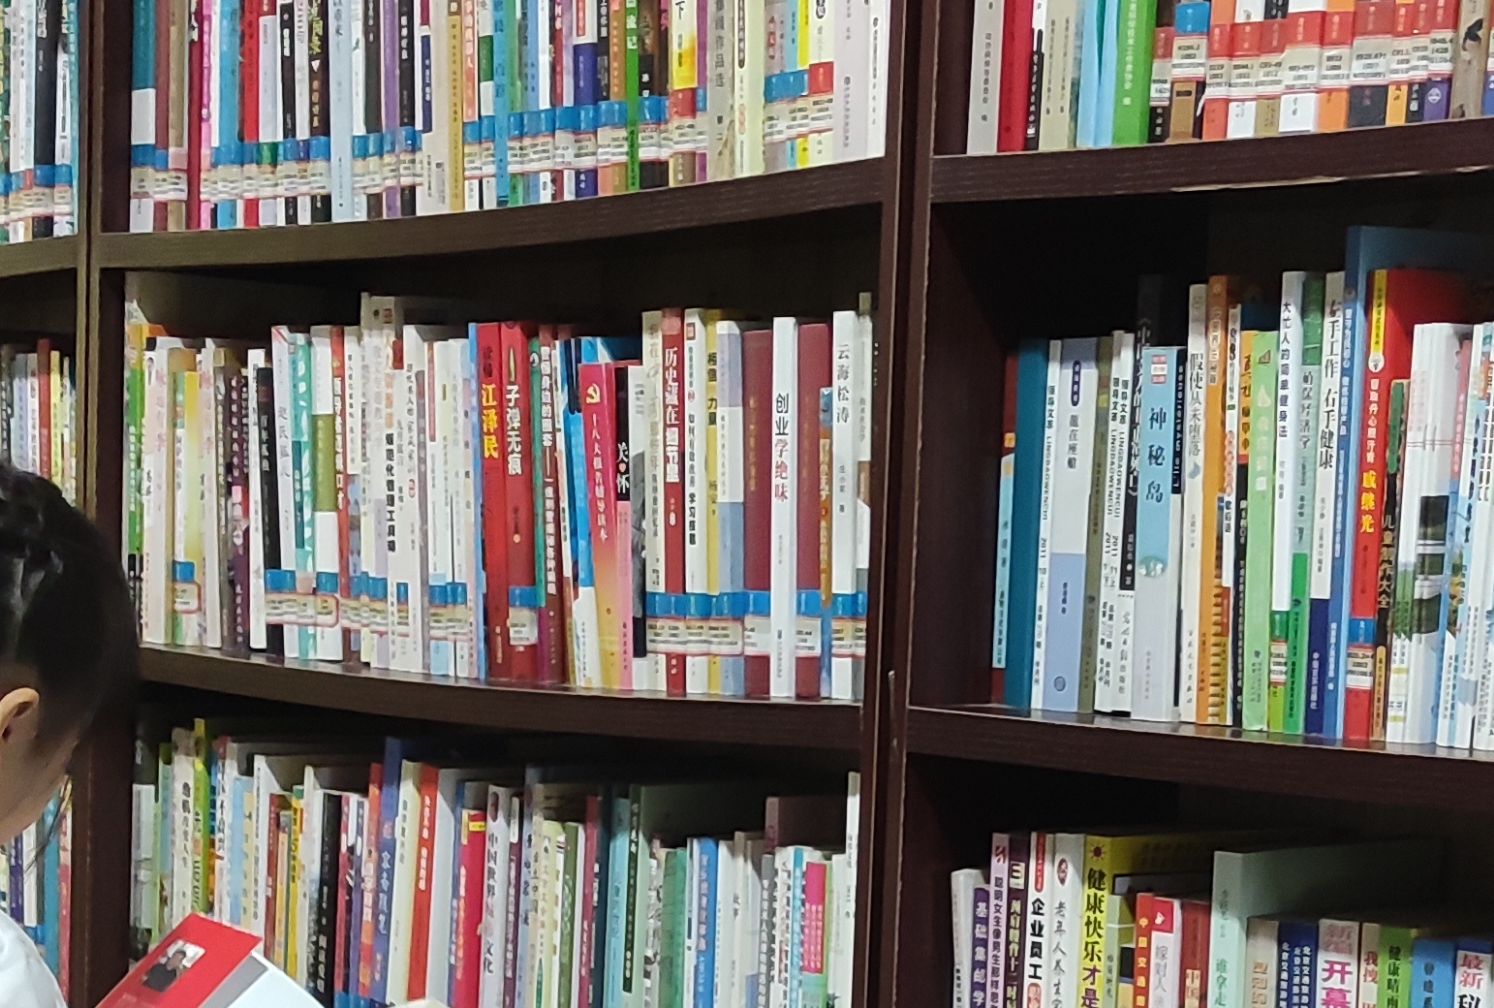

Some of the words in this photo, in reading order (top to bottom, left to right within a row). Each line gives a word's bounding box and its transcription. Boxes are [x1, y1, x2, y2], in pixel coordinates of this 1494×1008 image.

[836, 345, 851, 424] 云海松涛
[1278, 301, 1291, 438] 大忙人的简单健身法
[481, 384, 499, 460] 江泽民
[506, 385, 522, 476] 子弹无痕
[774, 393, 791, 502] 创业学绝味
[1146, 408, 1167, 503] 神秘岛
[1318, 388, 1338, 469] 右手健康
[1360, 470, 1377, 533] 戚继光
[1026, 898, 1045, 980] 企业员工
[1458, 954, 1484, 987] 最新
